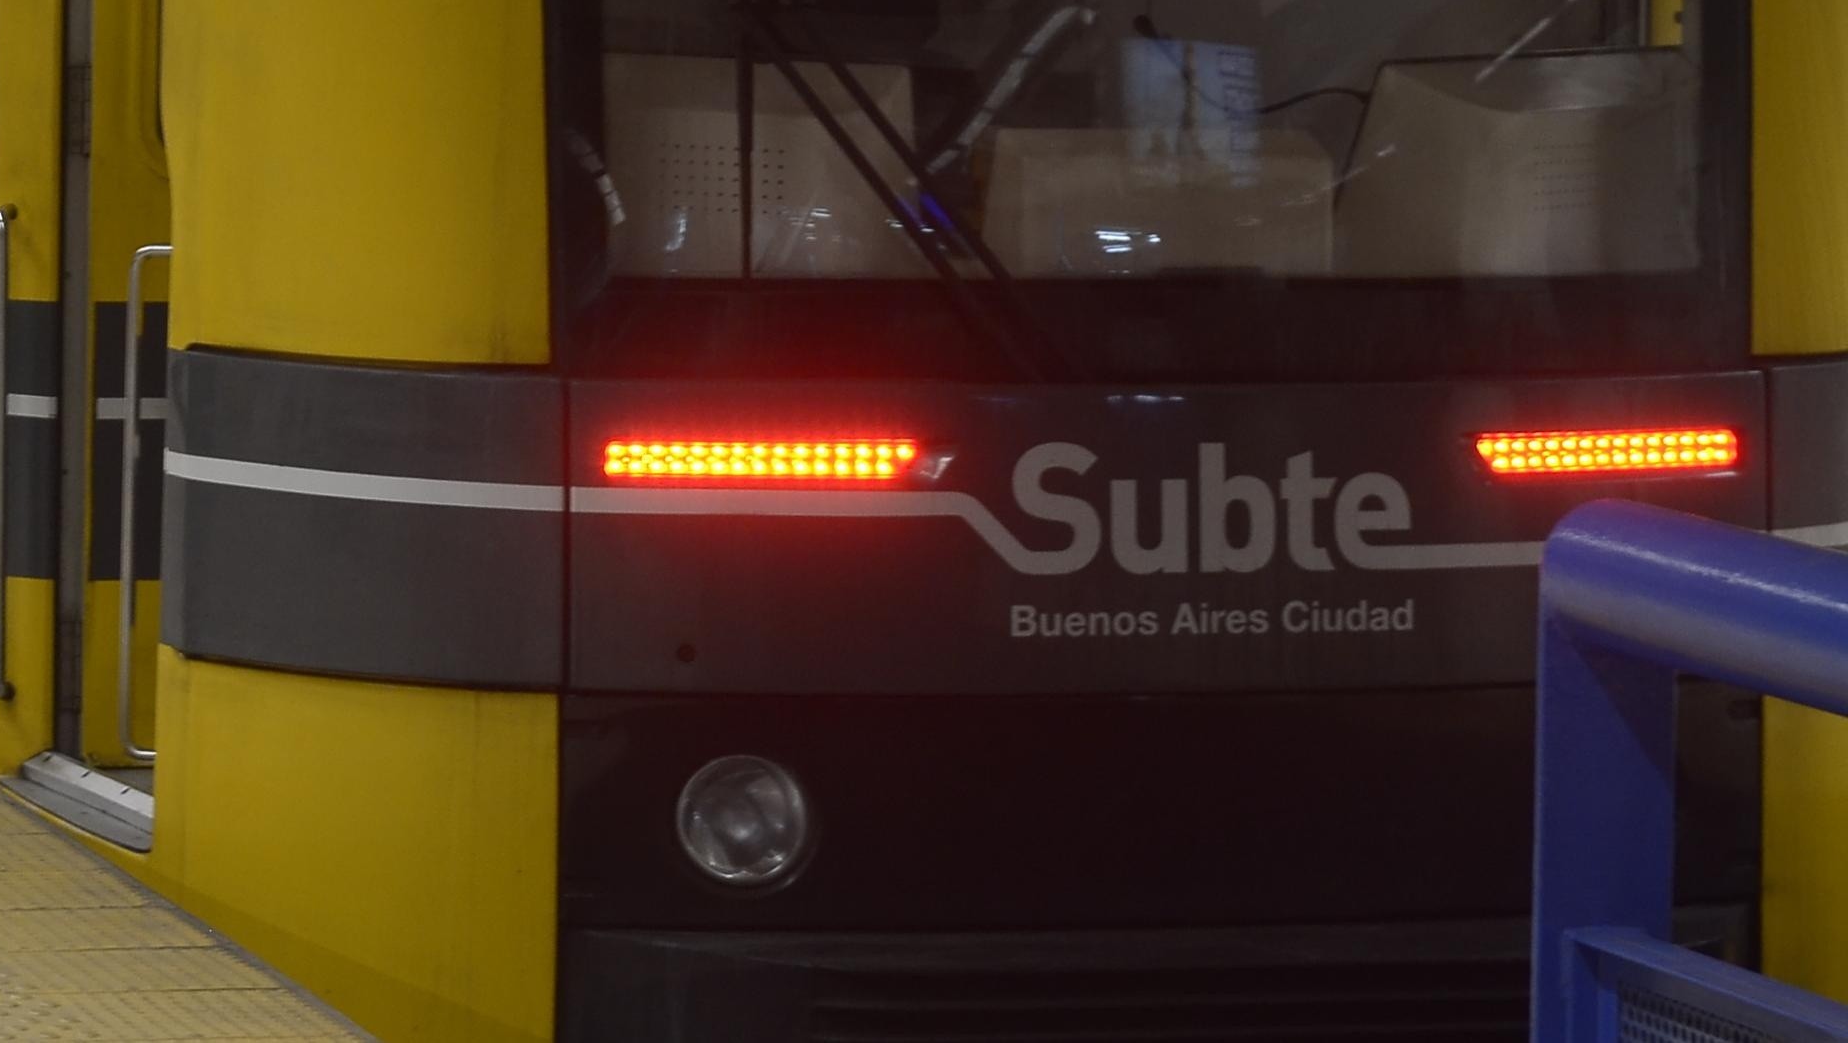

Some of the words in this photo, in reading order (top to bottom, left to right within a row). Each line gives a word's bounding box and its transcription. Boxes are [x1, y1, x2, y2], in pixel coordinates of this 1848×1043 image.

[1012, 441, 1412, 575] Subte
[1009, 603, 1160, 638] Buenos
[1170, 601, 1270, 636] Aires
[1281, 598, 1415, 634] Ciudad
